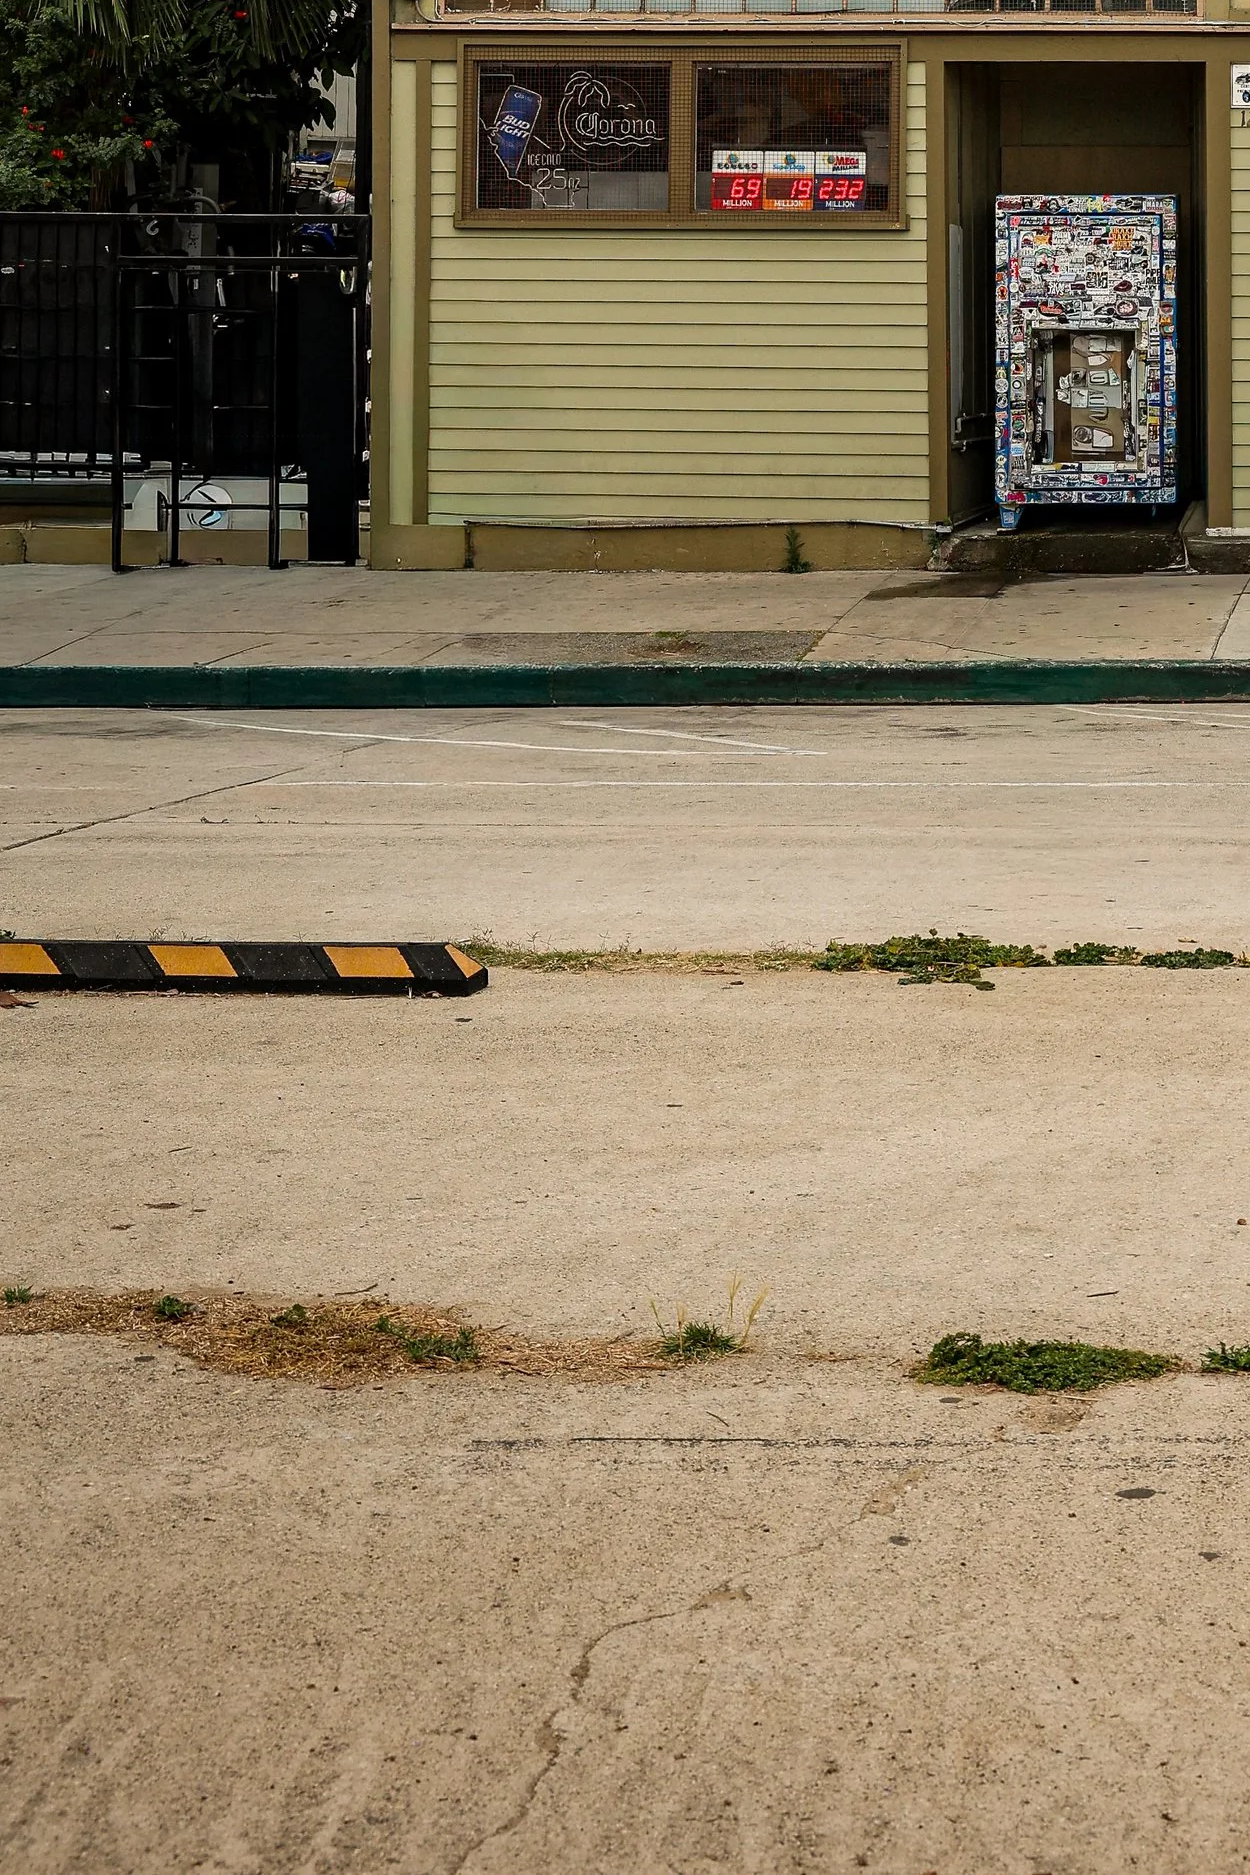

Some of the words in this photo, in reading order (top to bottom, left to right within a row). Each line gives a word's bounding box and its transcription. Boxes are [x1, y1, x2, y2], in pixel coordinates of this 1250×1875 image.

[502, 114, 531, 130] BUD
[576, 112, 657, 139] Corona
[730, 178, 762, 199] 69
[790, 179, 813, 199] 19
[818, 178, 864, 200] 232
[722, 199, 753, 208] MILLION
[774, 199, 804, 208] MILLION
[825, 200, 856, 209] MILLION
